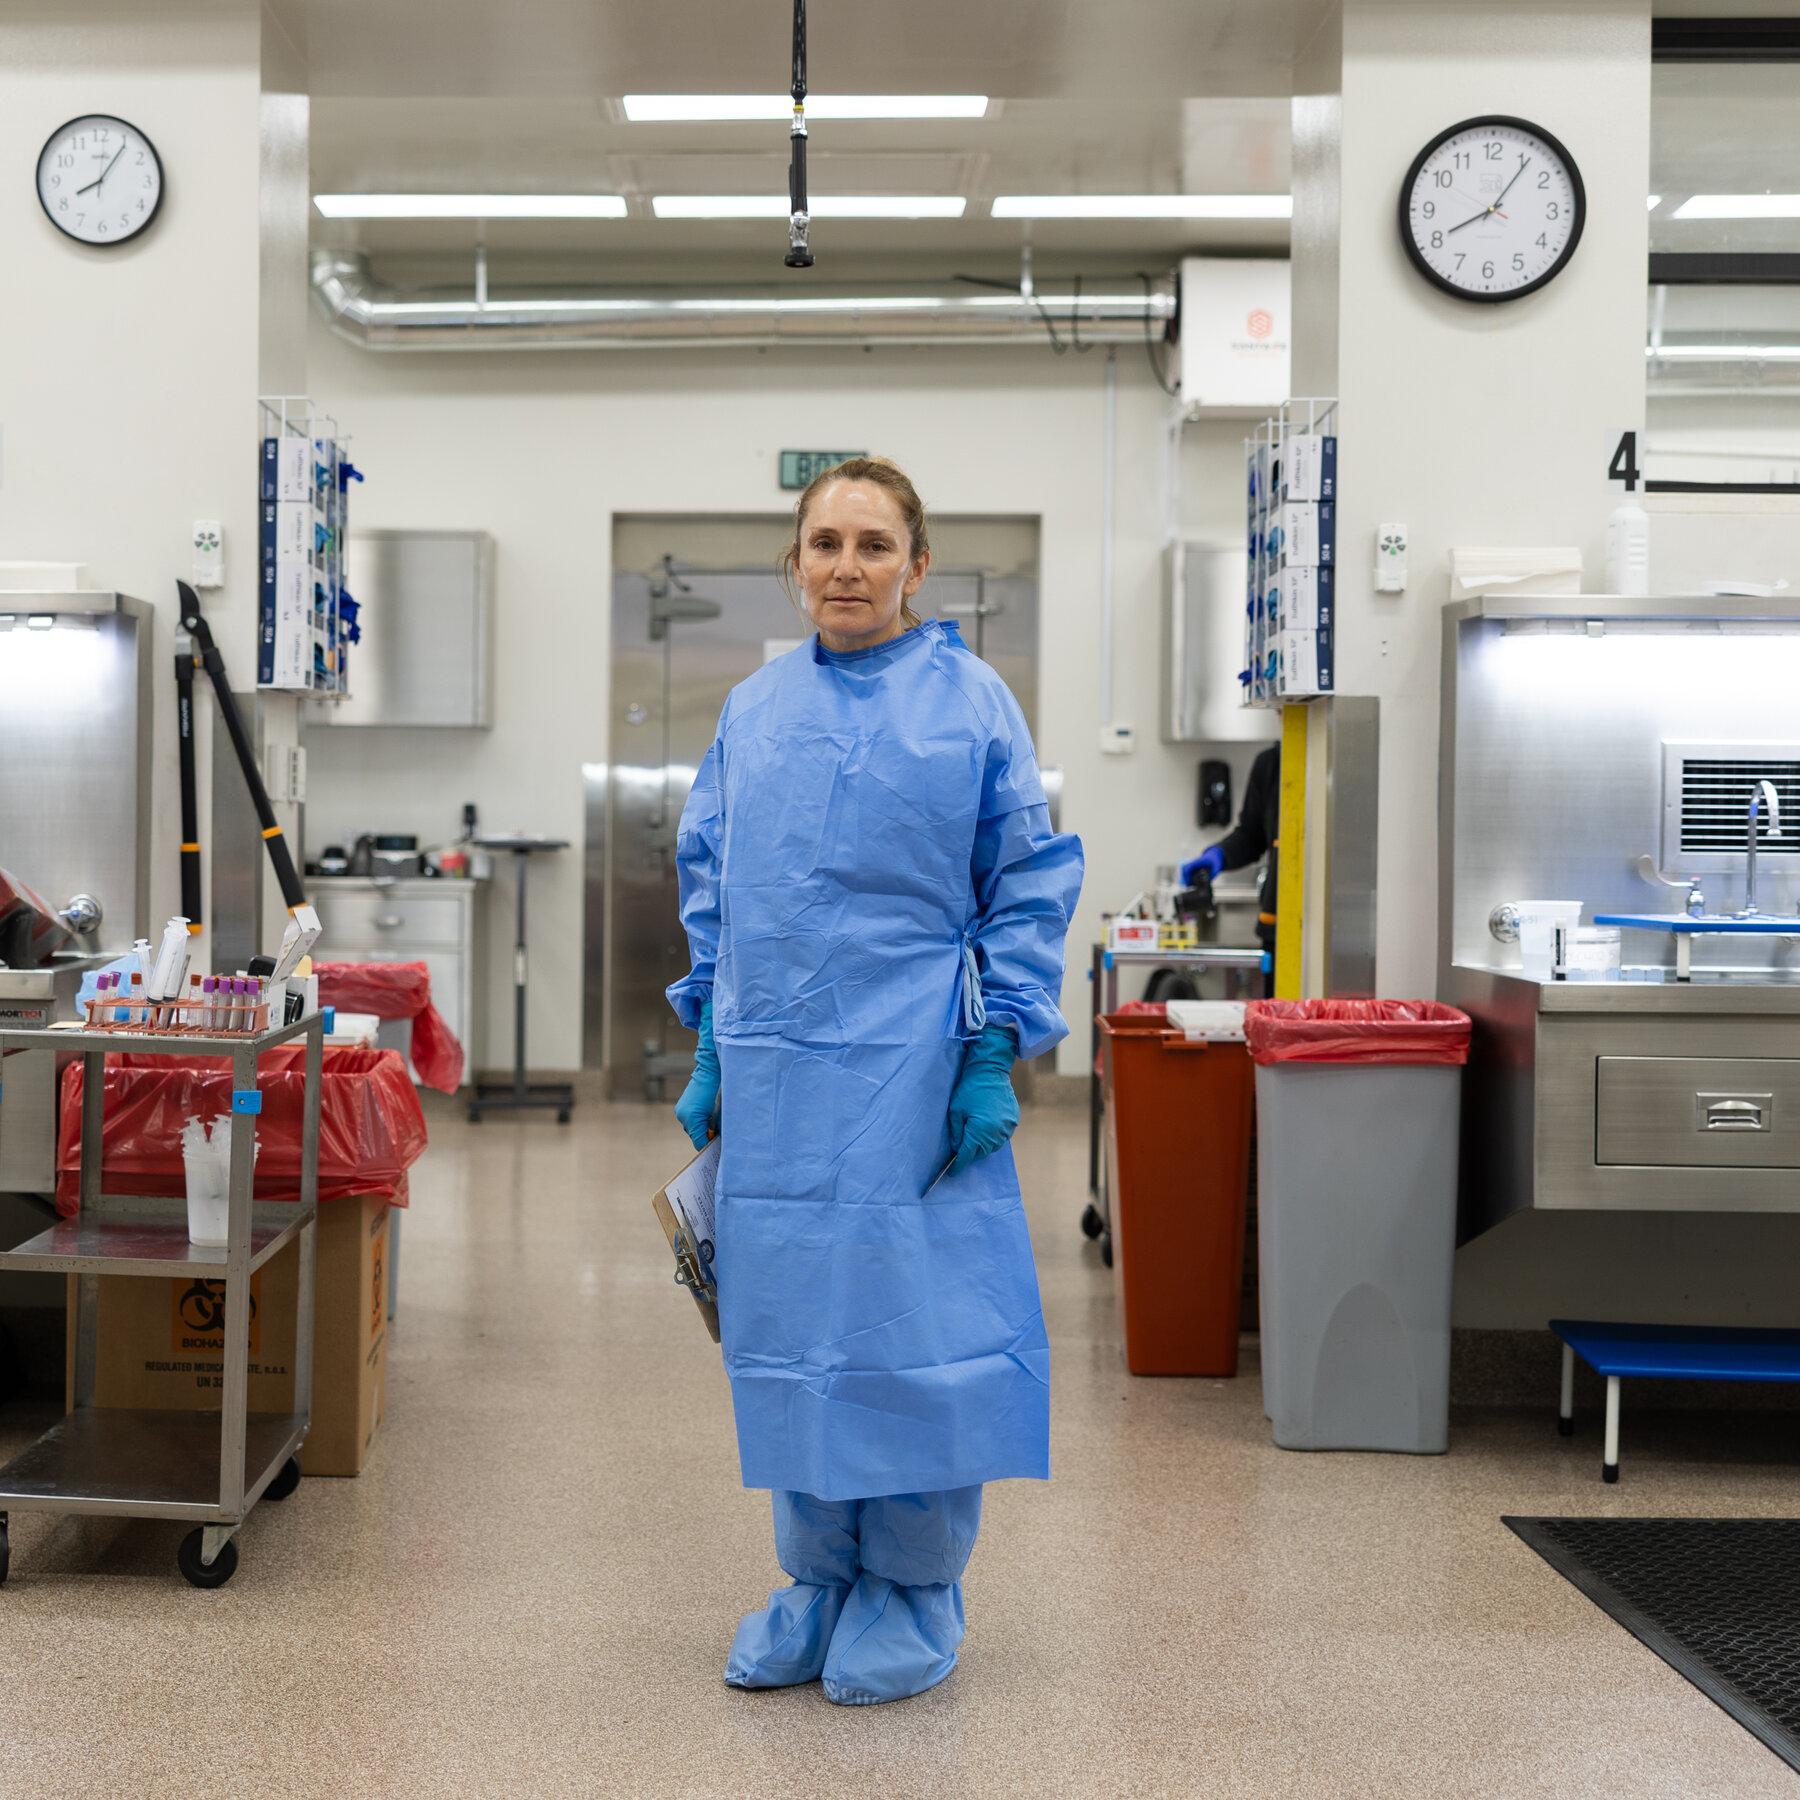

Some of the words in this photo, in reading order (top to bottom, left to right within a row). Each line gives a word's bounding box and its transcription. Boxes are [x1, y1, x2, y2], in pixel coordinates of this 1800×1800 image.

[72, 136, 85, 150] 11
[93, 128, 109, 143] 12
[136, 152, 145, 166] 2
[1482, 142, 1503, 160] 12
[58, 154, 74, 168] 10
[1453, 152, 1470, 170] 11
[1517, 152, 1525, 169] 1
[51, 174, 61, 188] 9
[143, 175, 152, 189] 3
[1433, 170, 1453, 188] 10
[1538, 171, 1550, 189] 2
[59, 197, 69, 211] 8
[136, 198, 145, 212] 4
[1423, 201, 1435, 219] 9
[1546, 202, 1559, 220] 3
[77, 213, 85, 227] 7
[97, 220, 107, 234] 6
[120, 213, 129, 228] 5
[1431, 231, 1443, 249] 8
[1535, 232, 1548, 249] 4
[1454, 254, 1466, 271] 7
[1482, 261, 1495, 279] 6
[1512, 253, 1524, 271] 5
[1608, 431, 1640, 491] 4
[145, 1361, 192, 1372] REGULATED
[194, 1363, 224, 1373] MEDICA
[197, 1377, 210, 1387] UN
